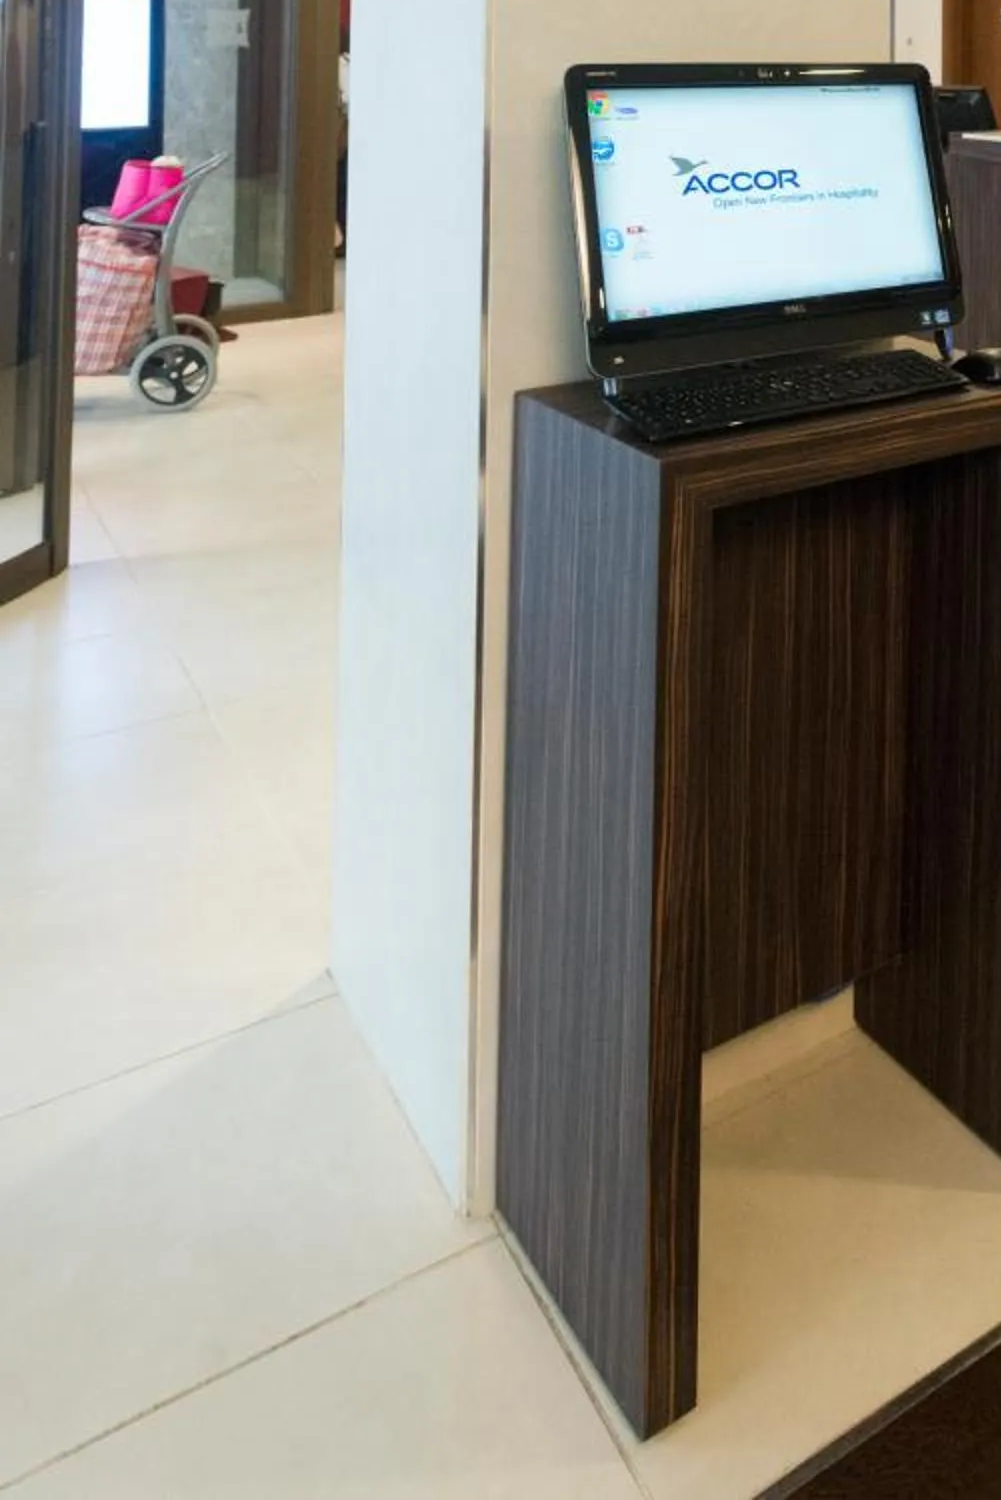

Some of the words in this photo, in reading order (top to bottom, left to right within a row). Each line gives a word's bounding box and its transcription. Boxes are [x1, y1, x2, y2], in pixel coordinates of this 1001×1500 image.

[682, 169, 800, 196] ACCOR
[713, 196, 742, 209] Open
[745, 195, 767, 205] New
